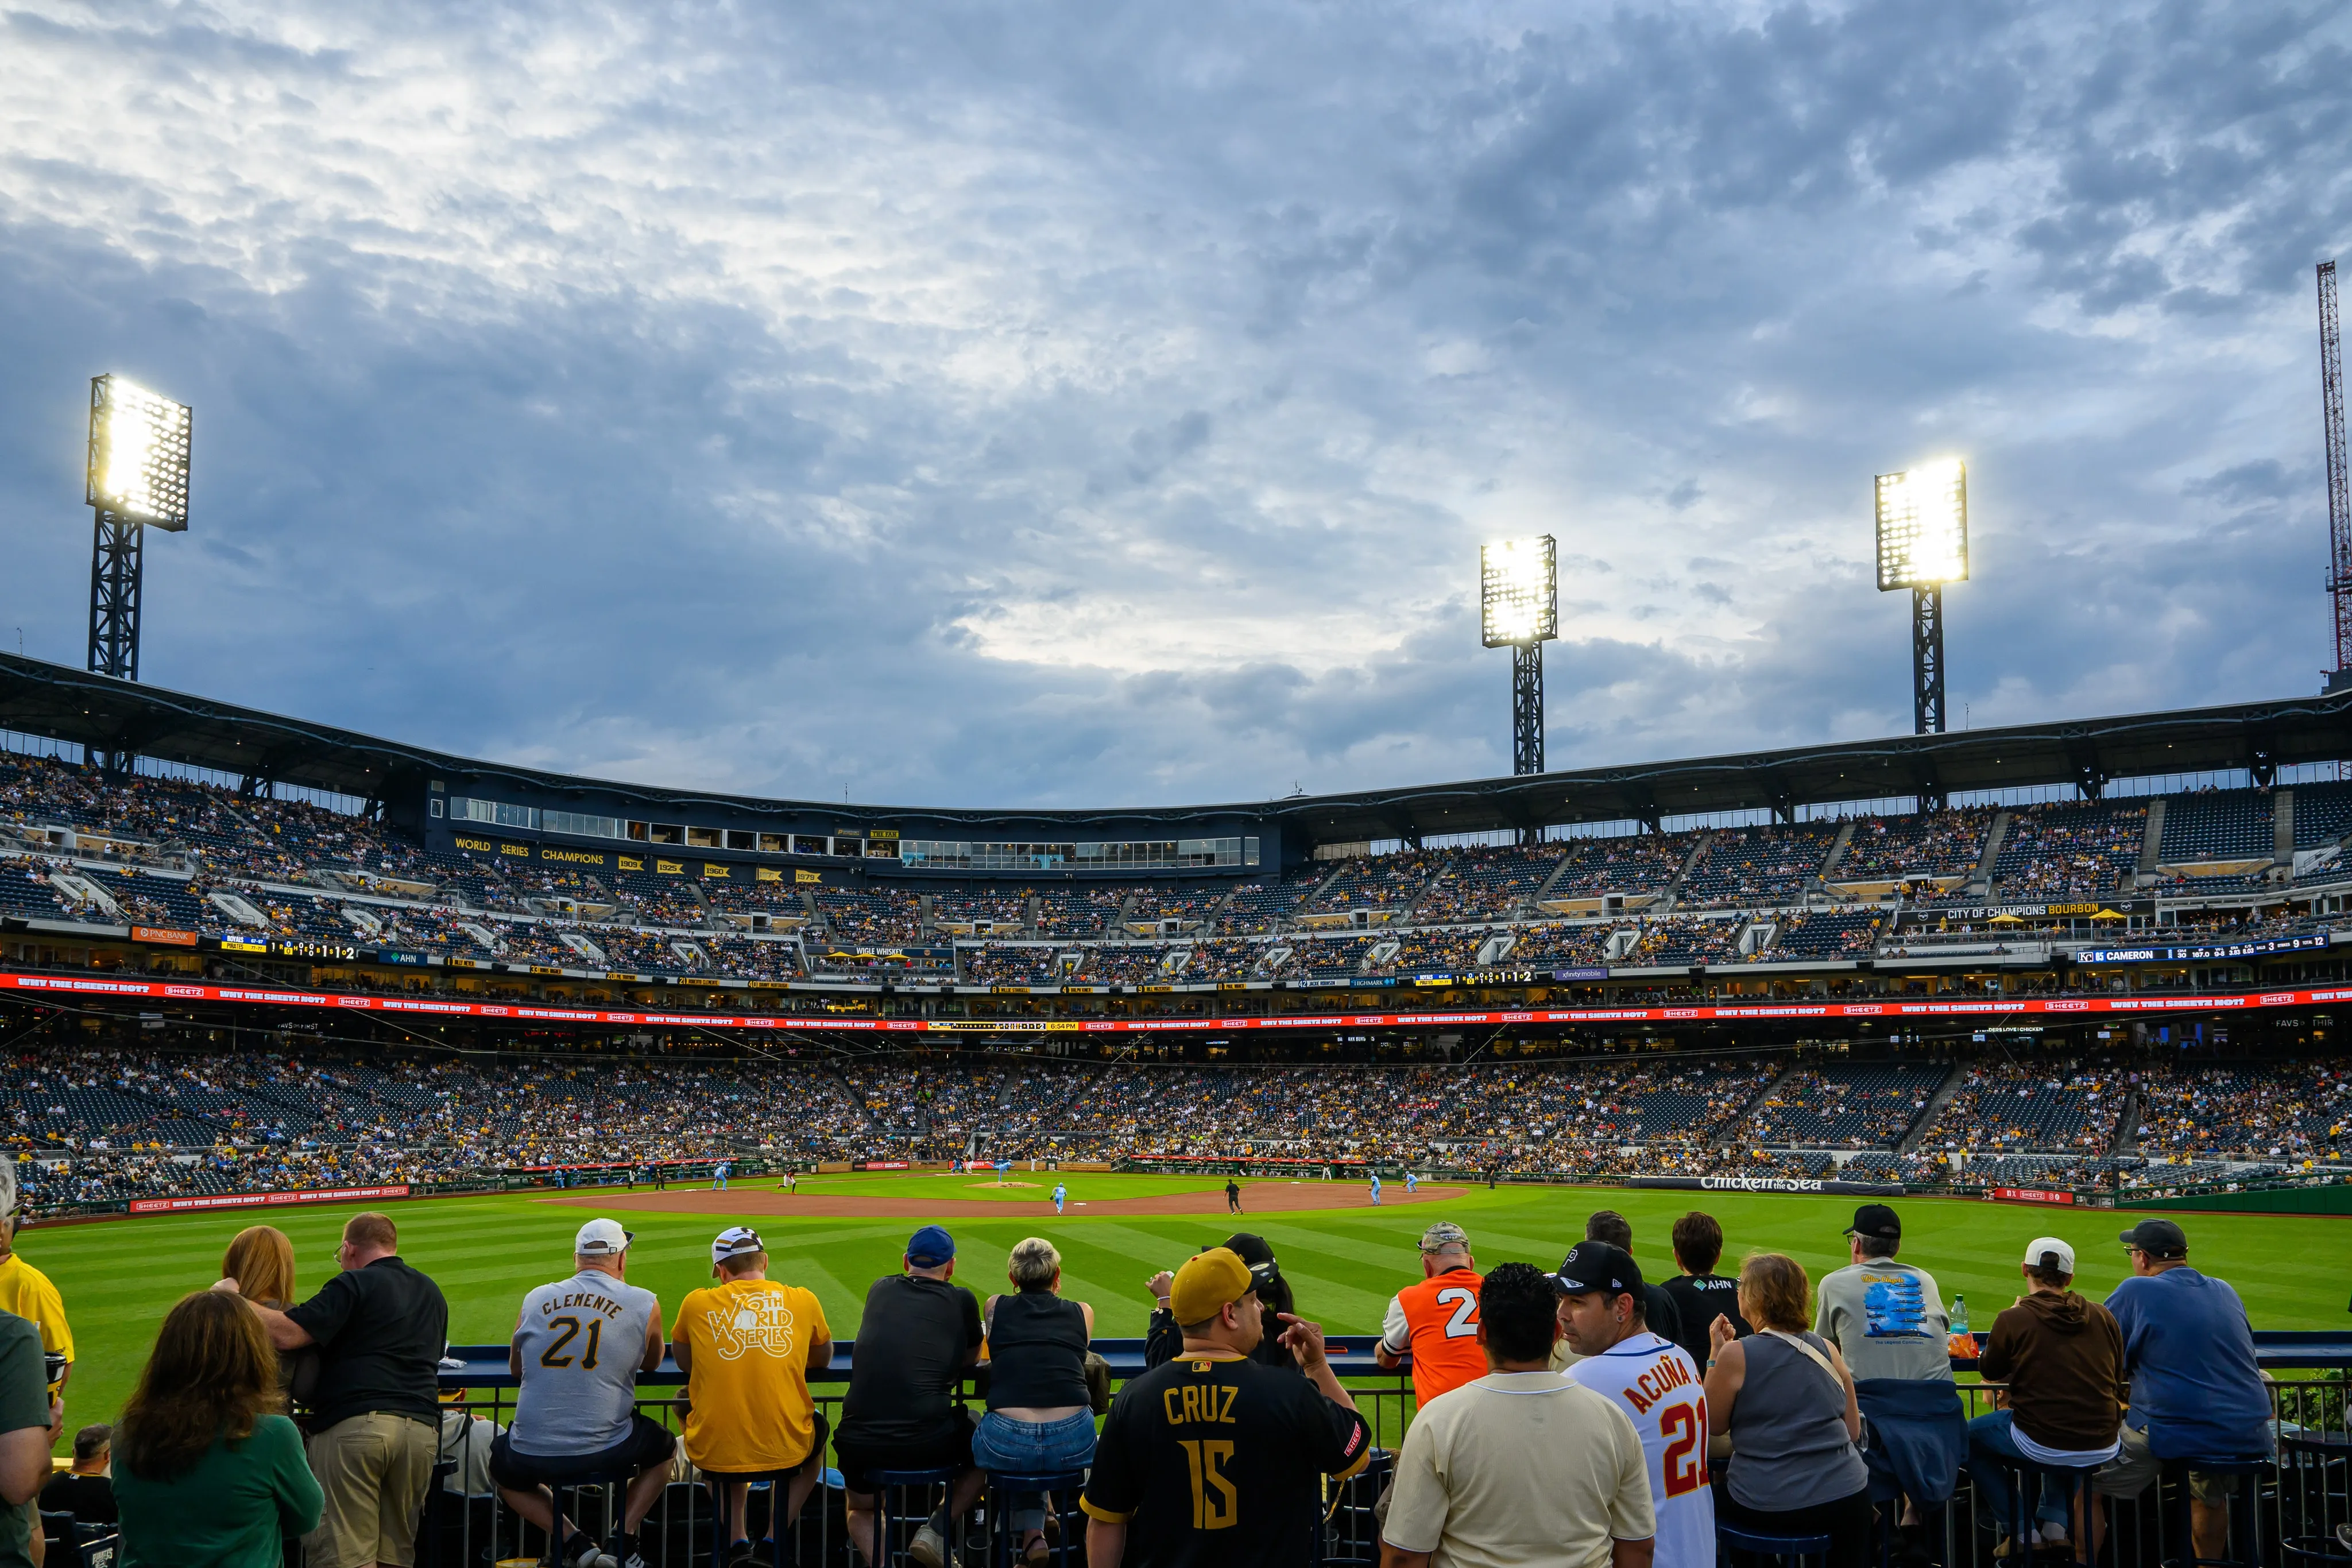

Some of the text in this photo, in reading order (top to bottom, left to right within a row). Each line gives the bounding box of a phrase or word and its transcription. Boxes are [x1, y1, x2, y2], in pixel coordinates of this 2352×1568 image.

[456, 838, 604, 865] WORLD SERIES CHAMPIONS
[621, 860, 637, 868] 1909
[1948, 903, 2099, 919] CITY OF CHAMPIONS BOURBON
[150, 930, 188, 940] PNC BANK
[227, 935, 244, 943] ROYALS
[2268, 942, 2274, 951] 3
[2293, 939, 2300, 948] 9
[2314, 937, 2323, 945] 12
[323, 945, 327, 957] 1
[335, 946, 340, 958] 1
[347, 947, 354, 959] 2
[400, 954, 416, 962] AHN
[2080, 951, 2153, 962] KC 65 CAMERON
[531, 966, 538, 974] 33
[18, 978, 149, 993] WHY THE SHEETZ NOT?
[167, 988, 201, 996] SHEETZ
[220, 990, 243, 999] WHY
[264, 993, 300, 1002] SHEETZ
[2215, 998, 2245, 1006] NOT?
[1701, 1177, 1773, 1192] Chicken
[1773, 1182, 1785, 1190] the
[1562, 1249, 1578, 1267] P
[1708, 1279, 1732, 1290] AHN
[1861, 1274, 1904, 1284] Blue Angels
[543, 1292, 622, 1320] CLEMENTE
[1437, 1287, 1479, 1339] 2
[540, 1315, 603, 1371] 21
[718, 1327, 794, 1361] SERIES
[1623, 1355, 1691, 1415] ACUÑA
[1165, 1385, 1239, 1425] CRUZ
[1659, 1395, 1709, 1500] 21
[1177, 1439, 1237, 1530] 15
